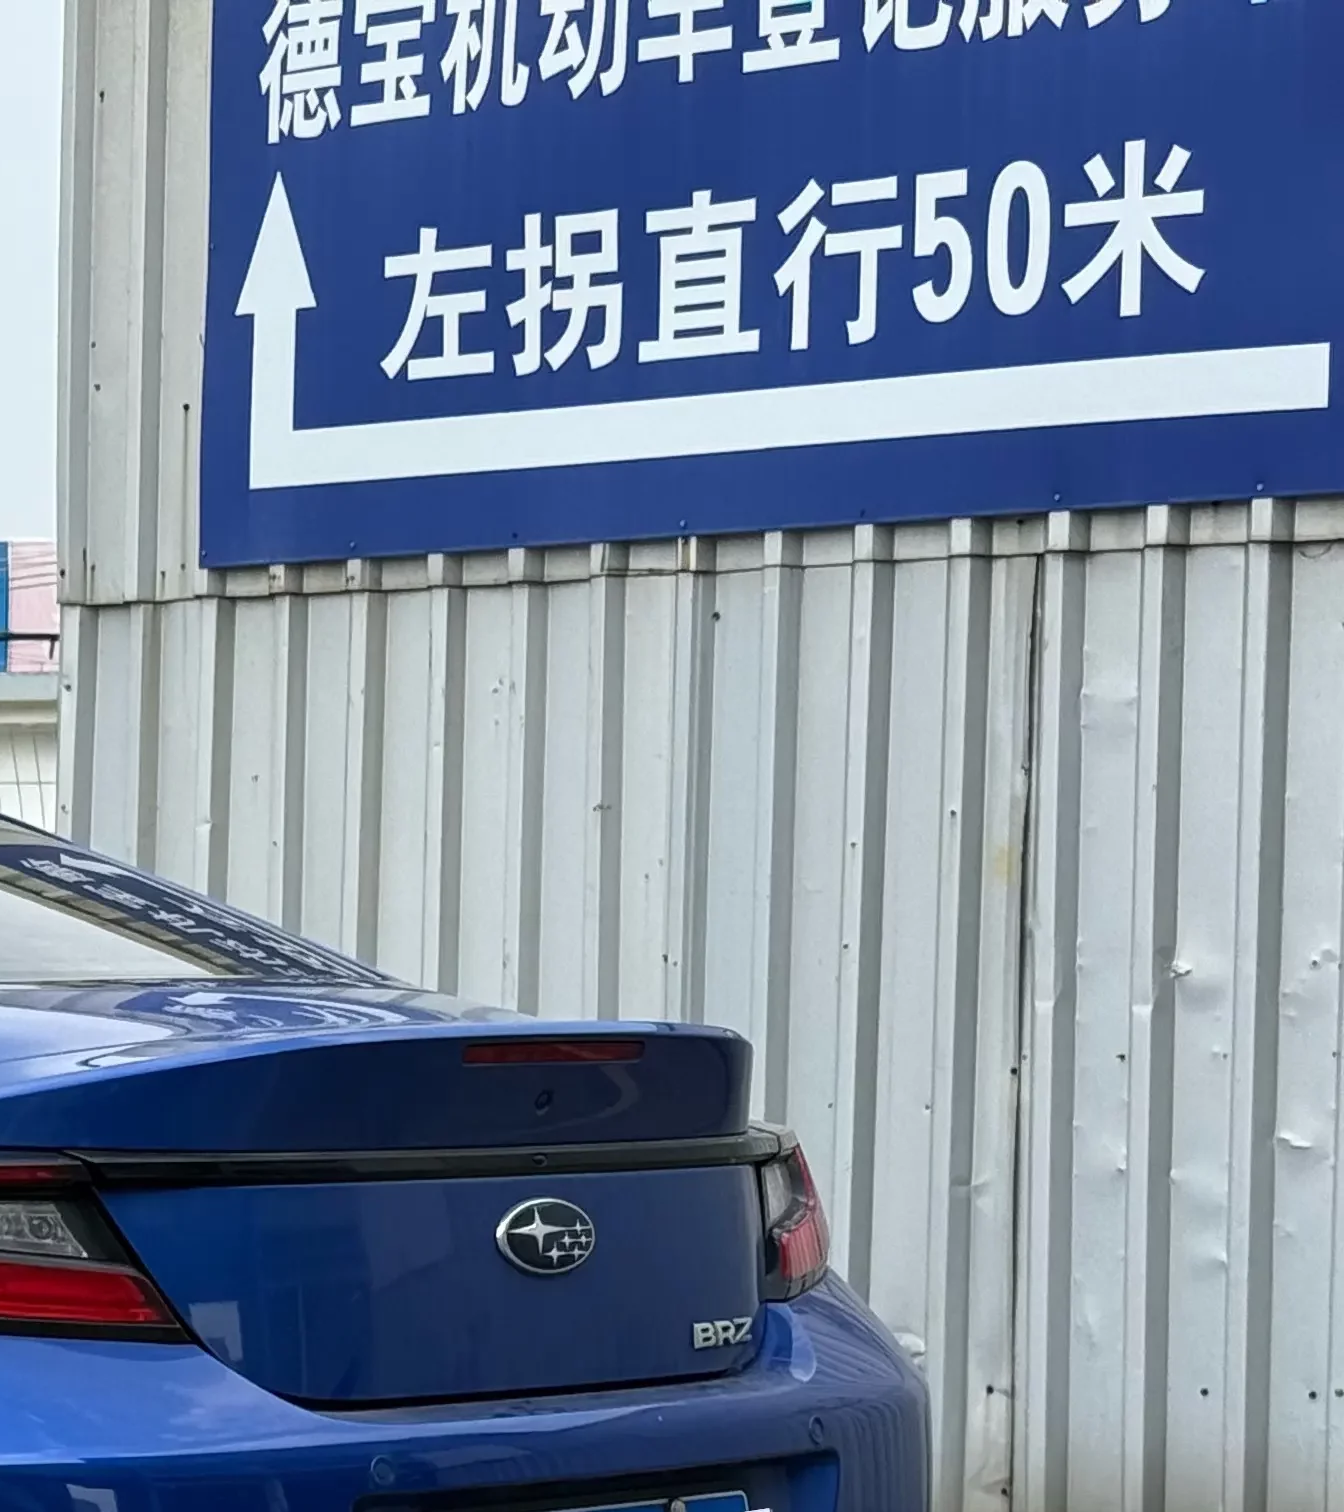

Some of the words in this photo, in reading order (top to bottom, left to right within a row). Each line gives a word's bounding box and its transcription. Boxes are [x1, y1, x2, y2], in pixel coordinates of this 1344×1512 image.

[258, 0, 1265, 145] 德宝机动车
[379, 139, 1206, 382] 左拐直行50米
[693, 1317, 753, 1349] BRZ
